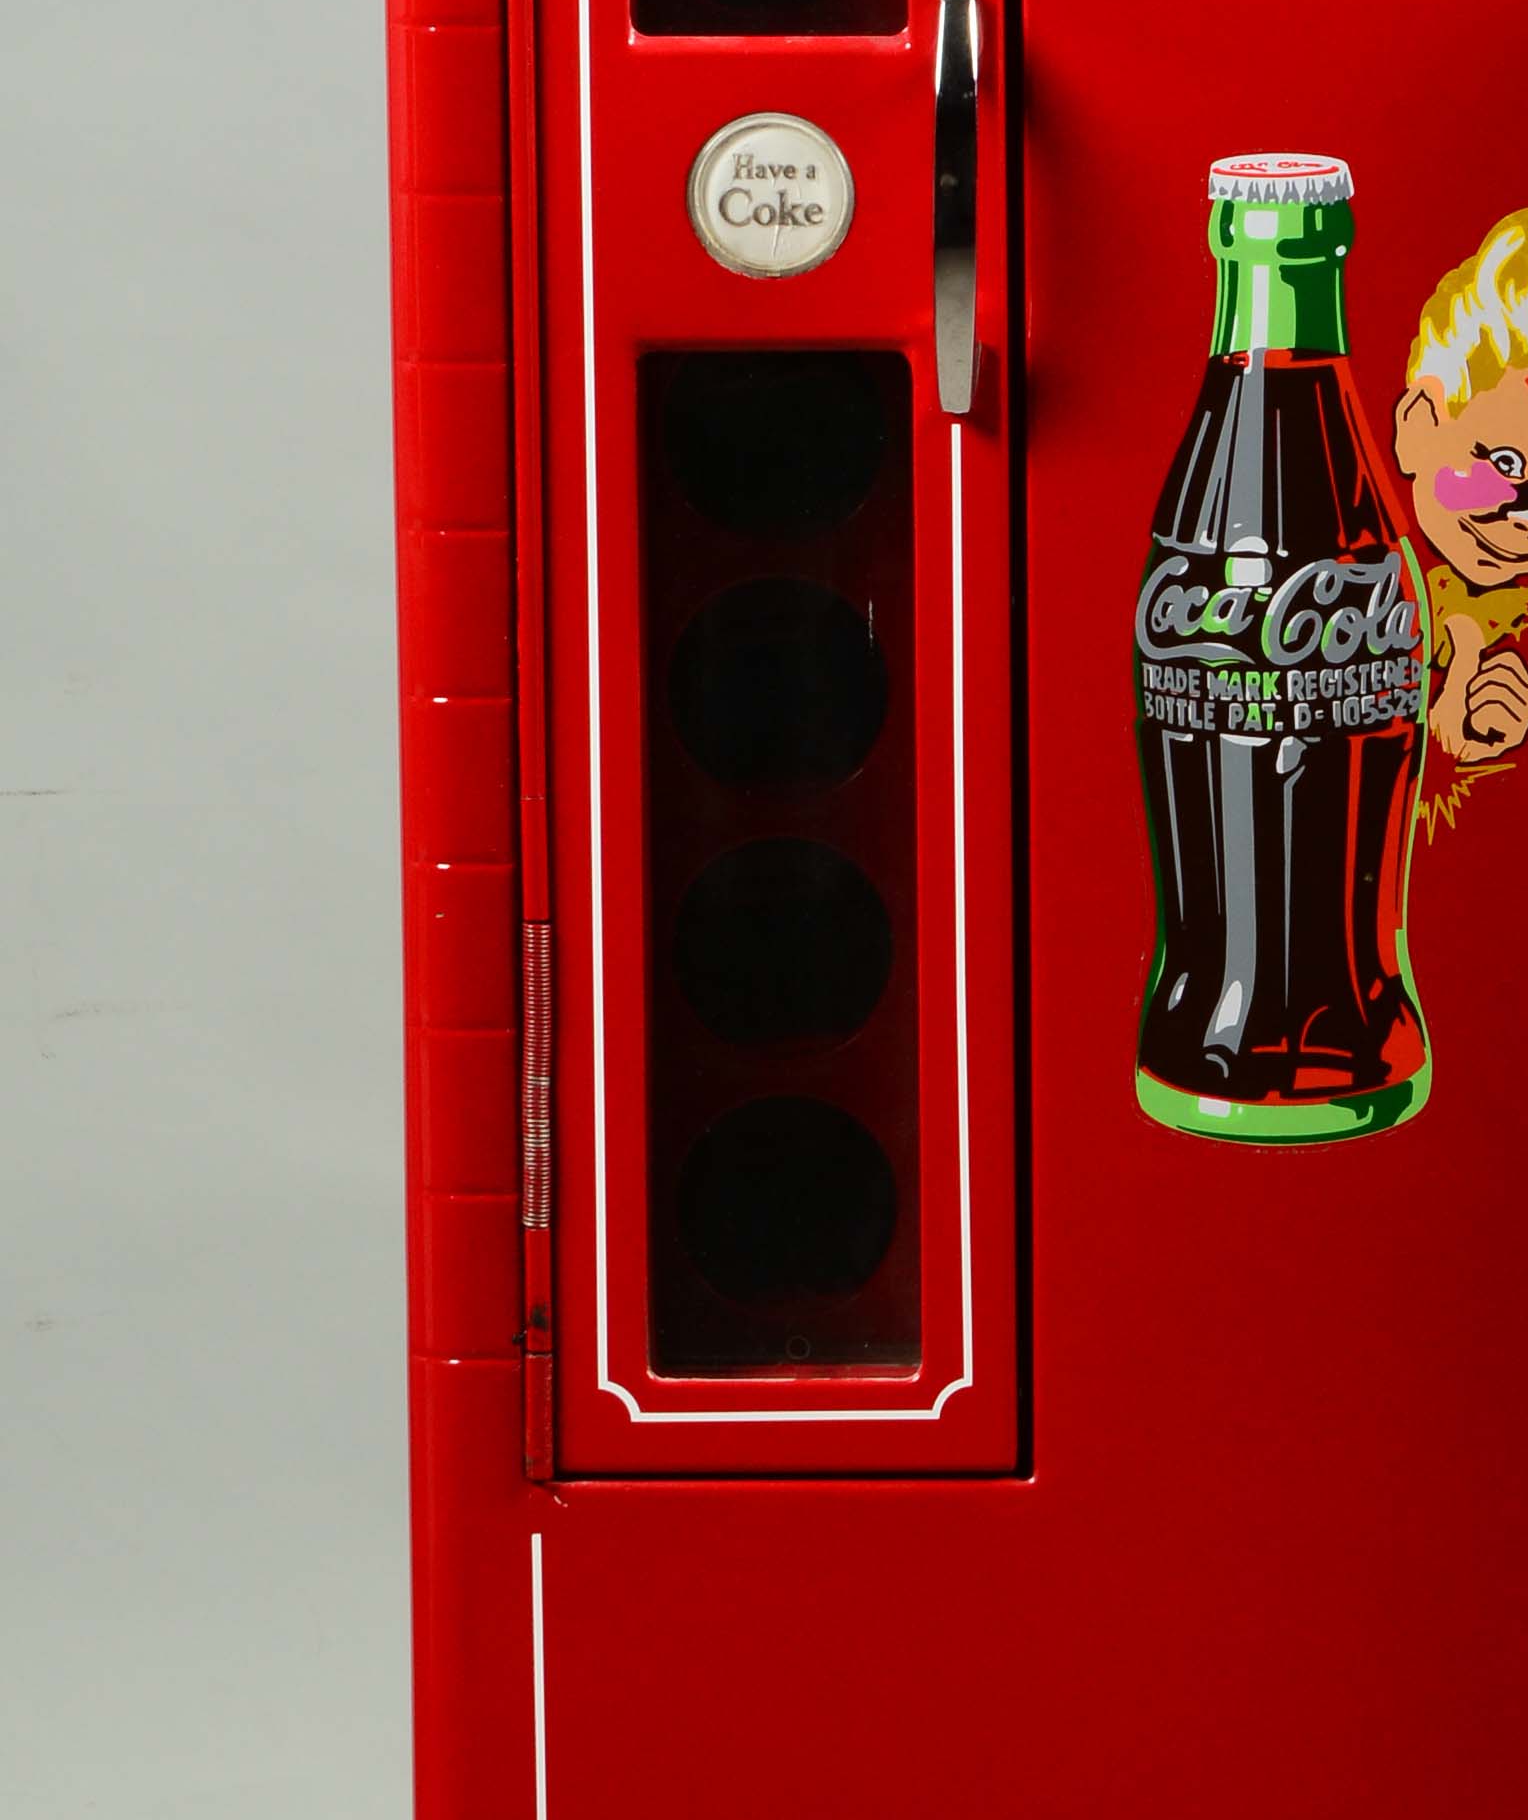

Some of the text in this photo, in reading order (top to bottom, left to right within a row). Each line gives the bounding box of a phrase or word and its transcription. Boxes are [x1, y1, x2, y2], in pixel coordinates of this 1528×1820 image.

[732, 152, 817, 181] Have a
[717, 186, 825, 228] Coke
[1134, 550, 1424, 667] Coca-Cola
[1141, 656, 1423, 702] TRADE MARK REGISTERED
[1143, 690, 1217, 730] BOTTLE
[1227, 702, 1285, 732] PAT.
